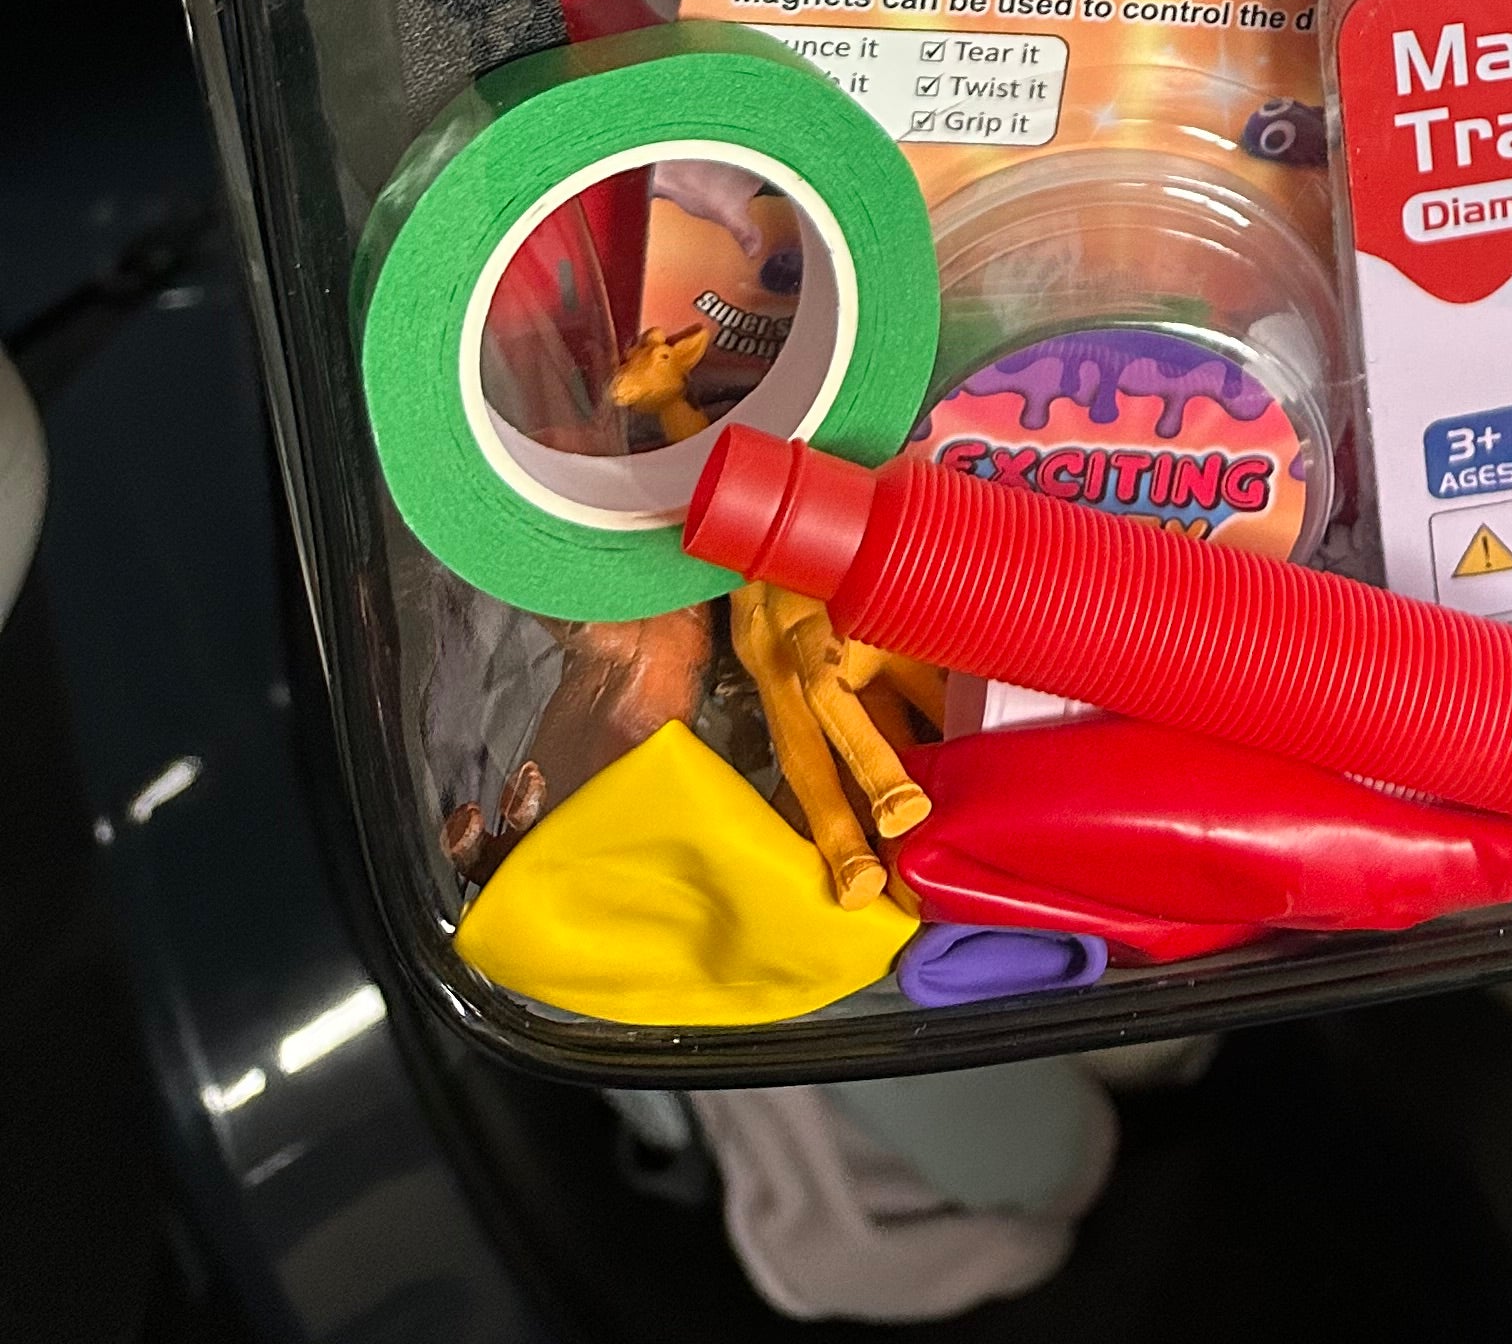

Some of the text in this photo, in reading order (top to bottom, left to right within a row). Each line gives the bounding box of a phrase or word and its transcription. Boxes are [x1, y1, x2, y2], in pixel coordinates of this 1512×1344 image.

[1122, 1, 1231, 26] control
[1239, 4, 1287, 29] the
[859, 36, 880, 59] it
[954, 40, 1041, 65] Tear it
[849, 71, 870, 93] it
[950, 76, 1048, 100] Twist it
[944, 111, 1031, 138] Grip it
[1446, 426, 1502, 463] 3+
[938, 440, 1275, 512] EXCITING
